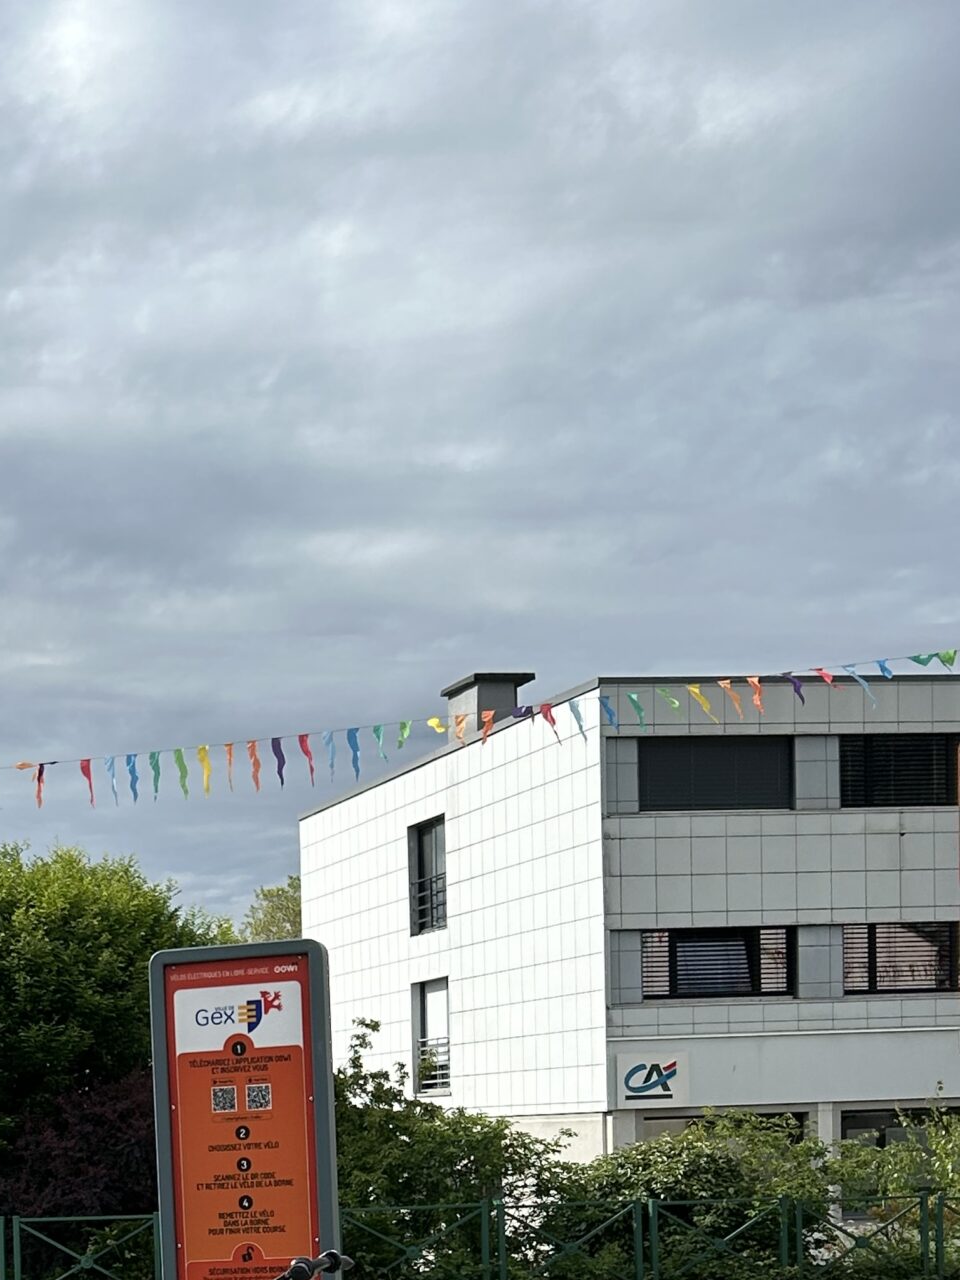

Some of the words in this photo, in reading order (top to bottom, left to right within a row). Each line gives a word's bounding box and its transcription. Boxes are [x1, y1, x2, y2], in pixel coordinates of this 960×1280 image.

[195, 1008, 236, 1027] Gex
[253, 1064, 269, 1072] VOUS
[240, 1129, 246, 1138] 2
[243, 1142, 262, 1151] VOTRE
[264, 1141, 280, 1149] VÉLO
[240, 1161, 247, 1170] 3
[213, 1173, 240, 1182] SCANNEZ
[241, 1172, 250, 1181] LE
[260, 1171, 276, 1180] CODE
[230, 1181, 239, 1189] LE
[264, 1179, 273, 1187] LA
[242, 1198, 249, 1207] 4
[218, 1211, 249, 1219] REMETTEZ
[259, 1209, 275, 1218] VÉLO
[223, 1219, 240, 1227] DANS
[249, 1218, 270, 1226] BORNE
[208, 1228, 225, 1236] POUR
[242, 1226, 261, 1234] VOTRE
[262, 1225, 286, 1233] COURSE
